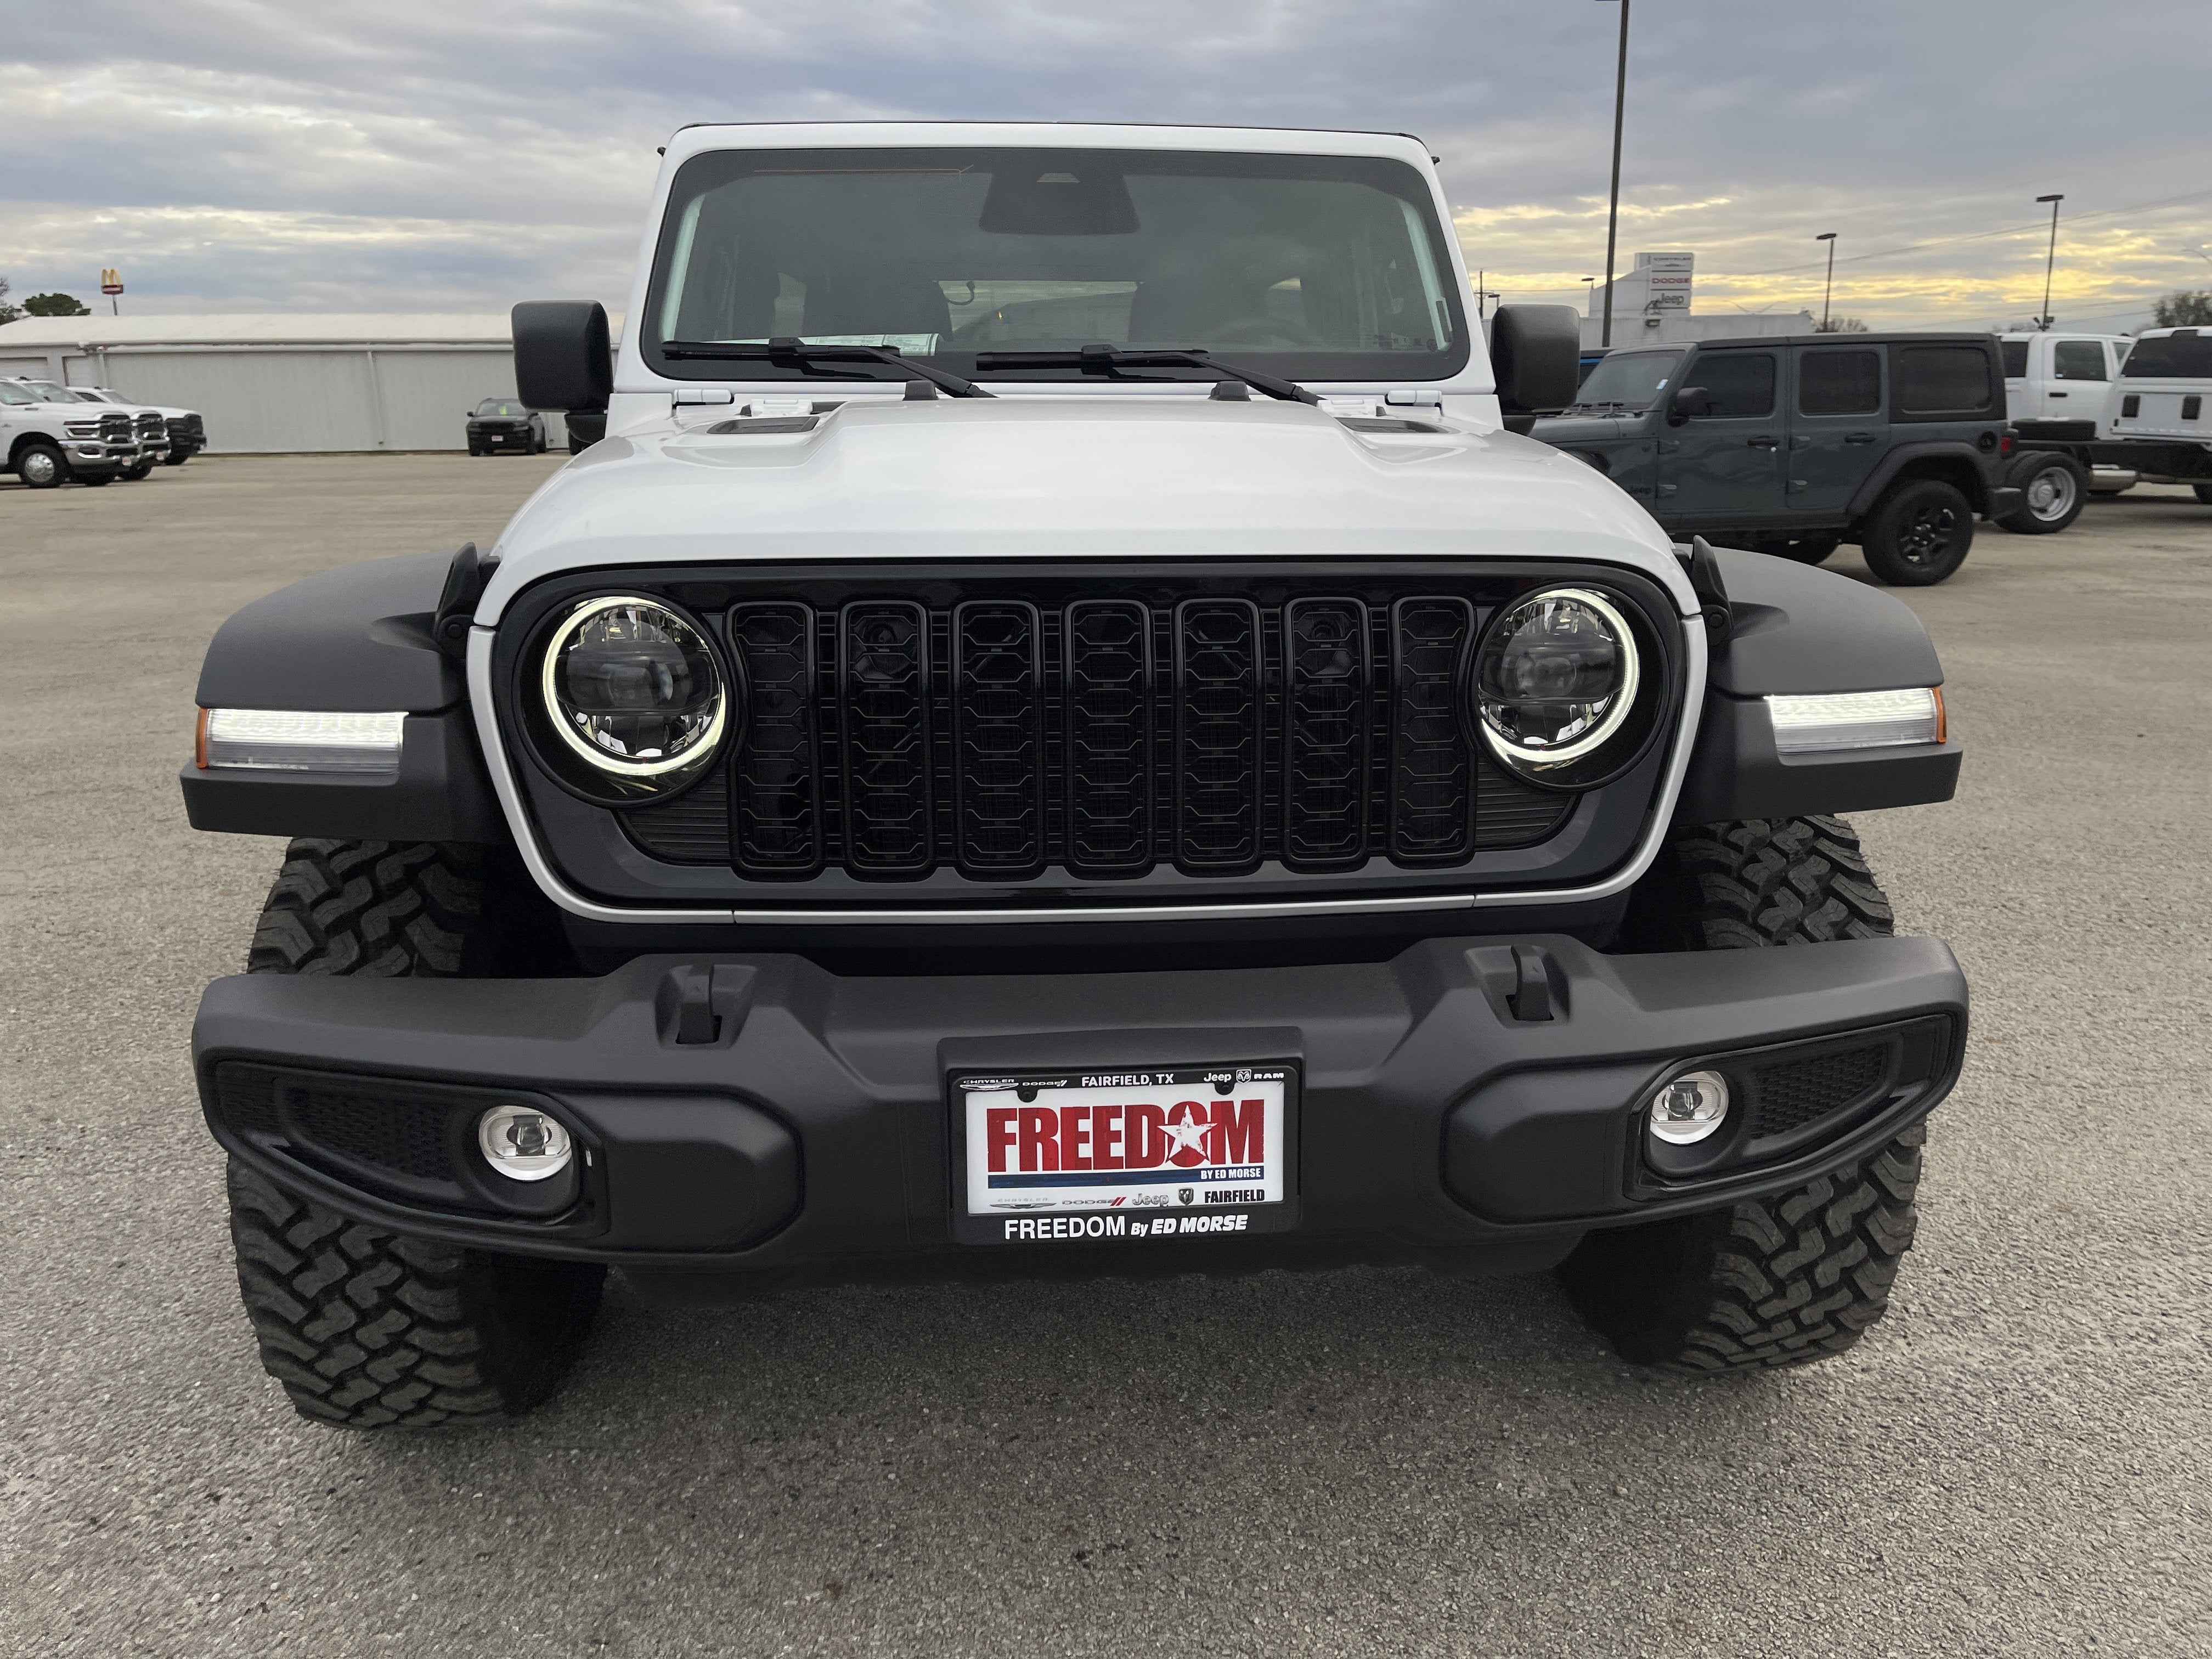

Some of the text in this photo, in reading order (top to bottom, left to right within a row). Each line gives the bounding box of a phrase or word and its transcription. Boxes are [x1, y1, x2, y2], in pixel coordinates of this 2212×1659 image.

[1081, 1073, 1174, 1087] FAIRFIELD, TX
[1204, 1073, 1232, 1082] Jeep
[986, 1099, 1265, 1173] FREEDOM
[1200, 1167, 1261, 1180] BY ED MORSE
[1132, 1193, 1170, 1207] Jeep
[1204, 1189, 1265, 1204] FAIRFIELD
[1005, 1214, 1249, 1240] FREEDOM By ED MORSE
